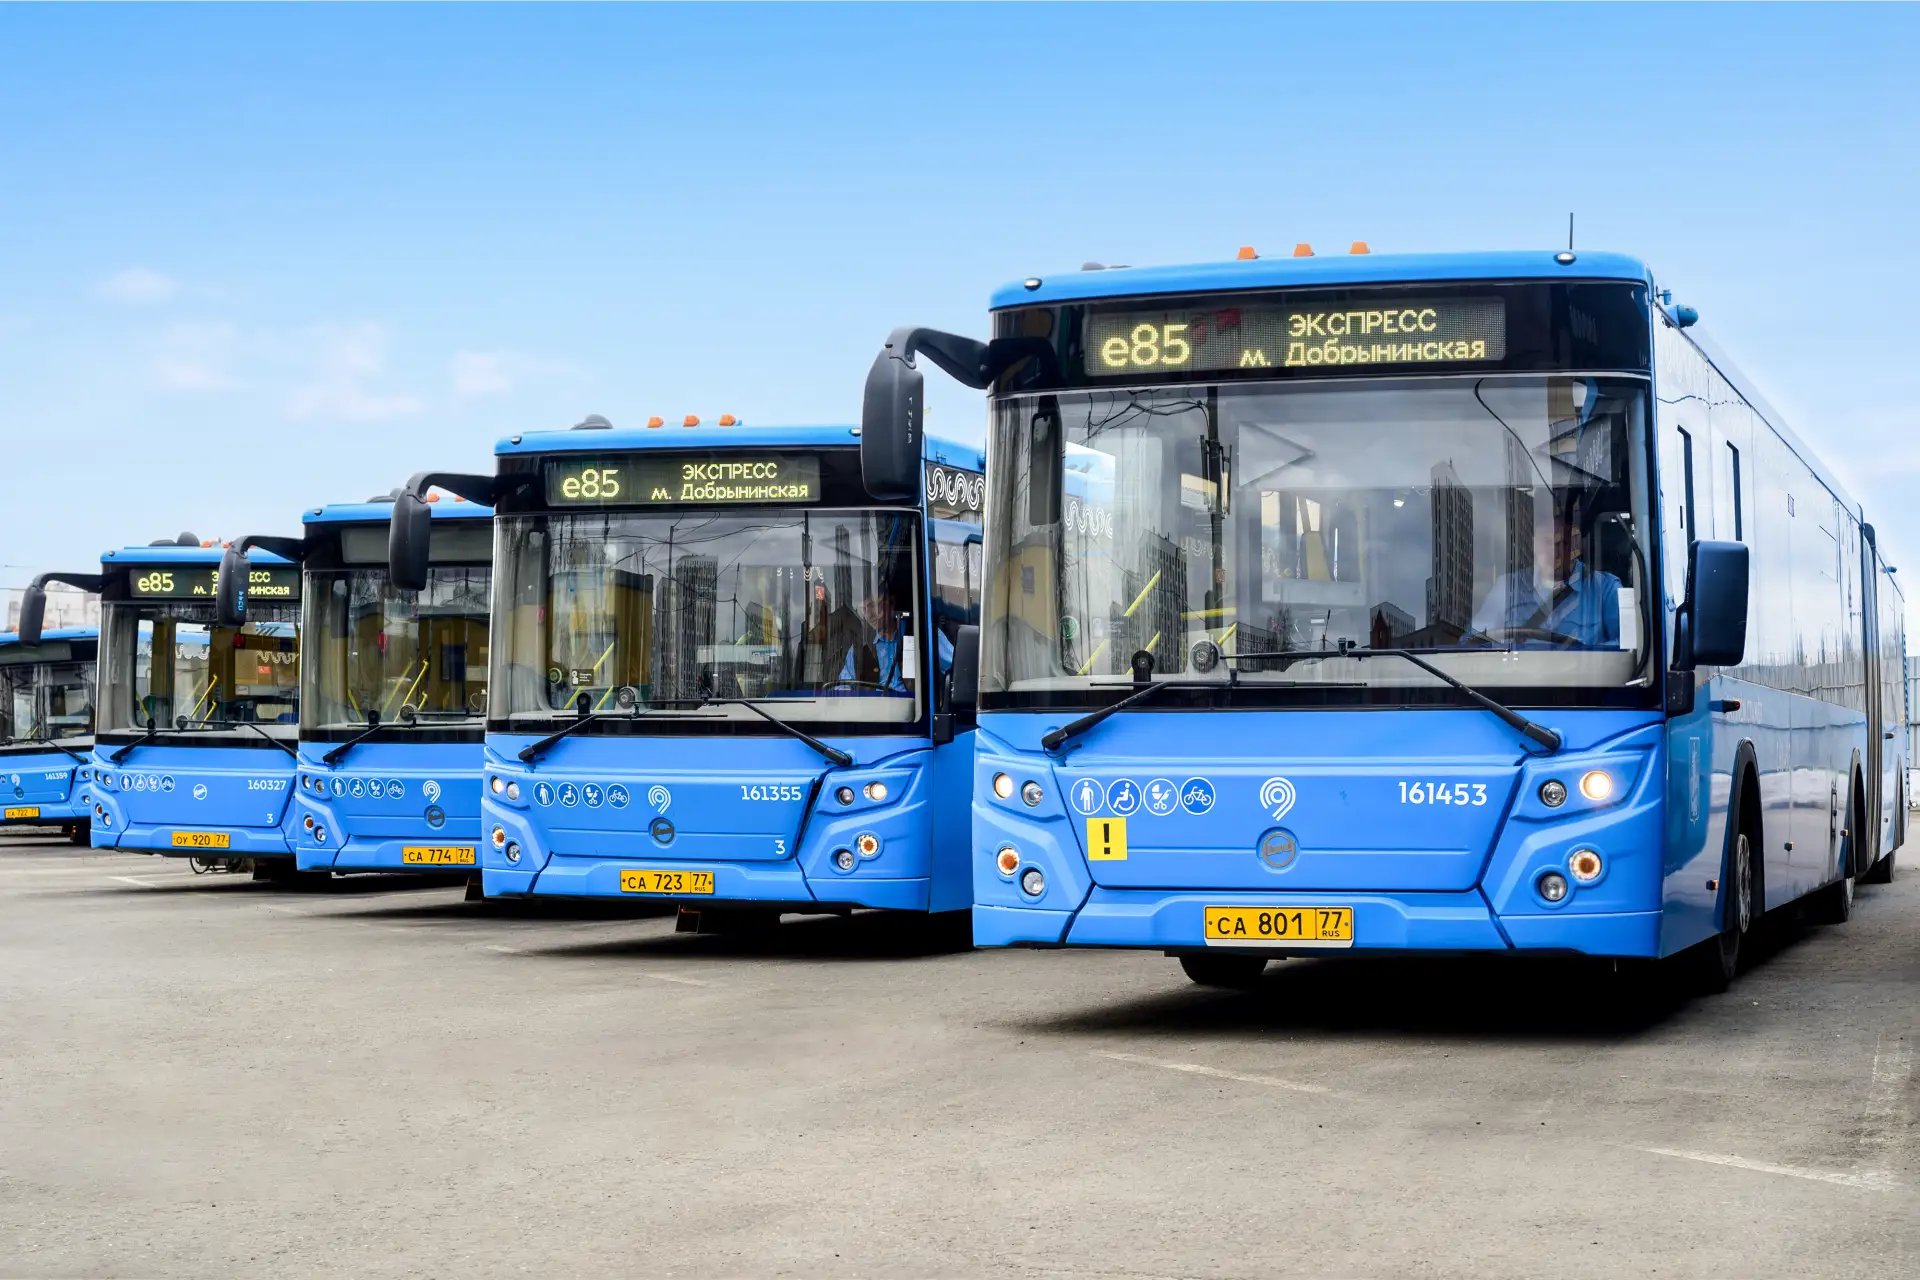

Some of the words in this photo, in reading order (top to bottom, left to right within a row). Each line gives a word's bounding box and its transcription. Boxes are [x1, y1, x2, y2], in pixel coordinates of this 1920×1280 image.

[1288, 309, 1437, 337] ЭКСПРЕСС
[1102, 324, 1190, 367] е85
[1240, 350, 1271, 367] м.
[1285, 338, 1485, 367] Добрынинская
[682, 462, 778, 480] ЭКСПРЕСС
[562, 469, 620, 498] е85
[651, 488, 672, 500] м.
[680, 482, 808, 500] Добрынинская
[137, 572, 175, 592] е85
[211, 571, 271, 583] ЭЕСС
[211, 584, 290, 596] Днинская
[247, 779, 287, 791] 160327
[740, 785, 802, 801] 161355
[1398, 781, 1488, 806] 161453
[266, 813, 274, 824] 3
[192, 834, 210, 846] 920
[215, 834, 226, 843] 77
[775, 839, 786, 855] 3
[428, 849, 451, 862] 774
[458, 848, 470, 858] 77
[653, 873, 682, 890] 723
[692, 873, 708, 886] 77
[1258, 912, 1303, 935] 801
[1319, 911, 1343, 929] 77
